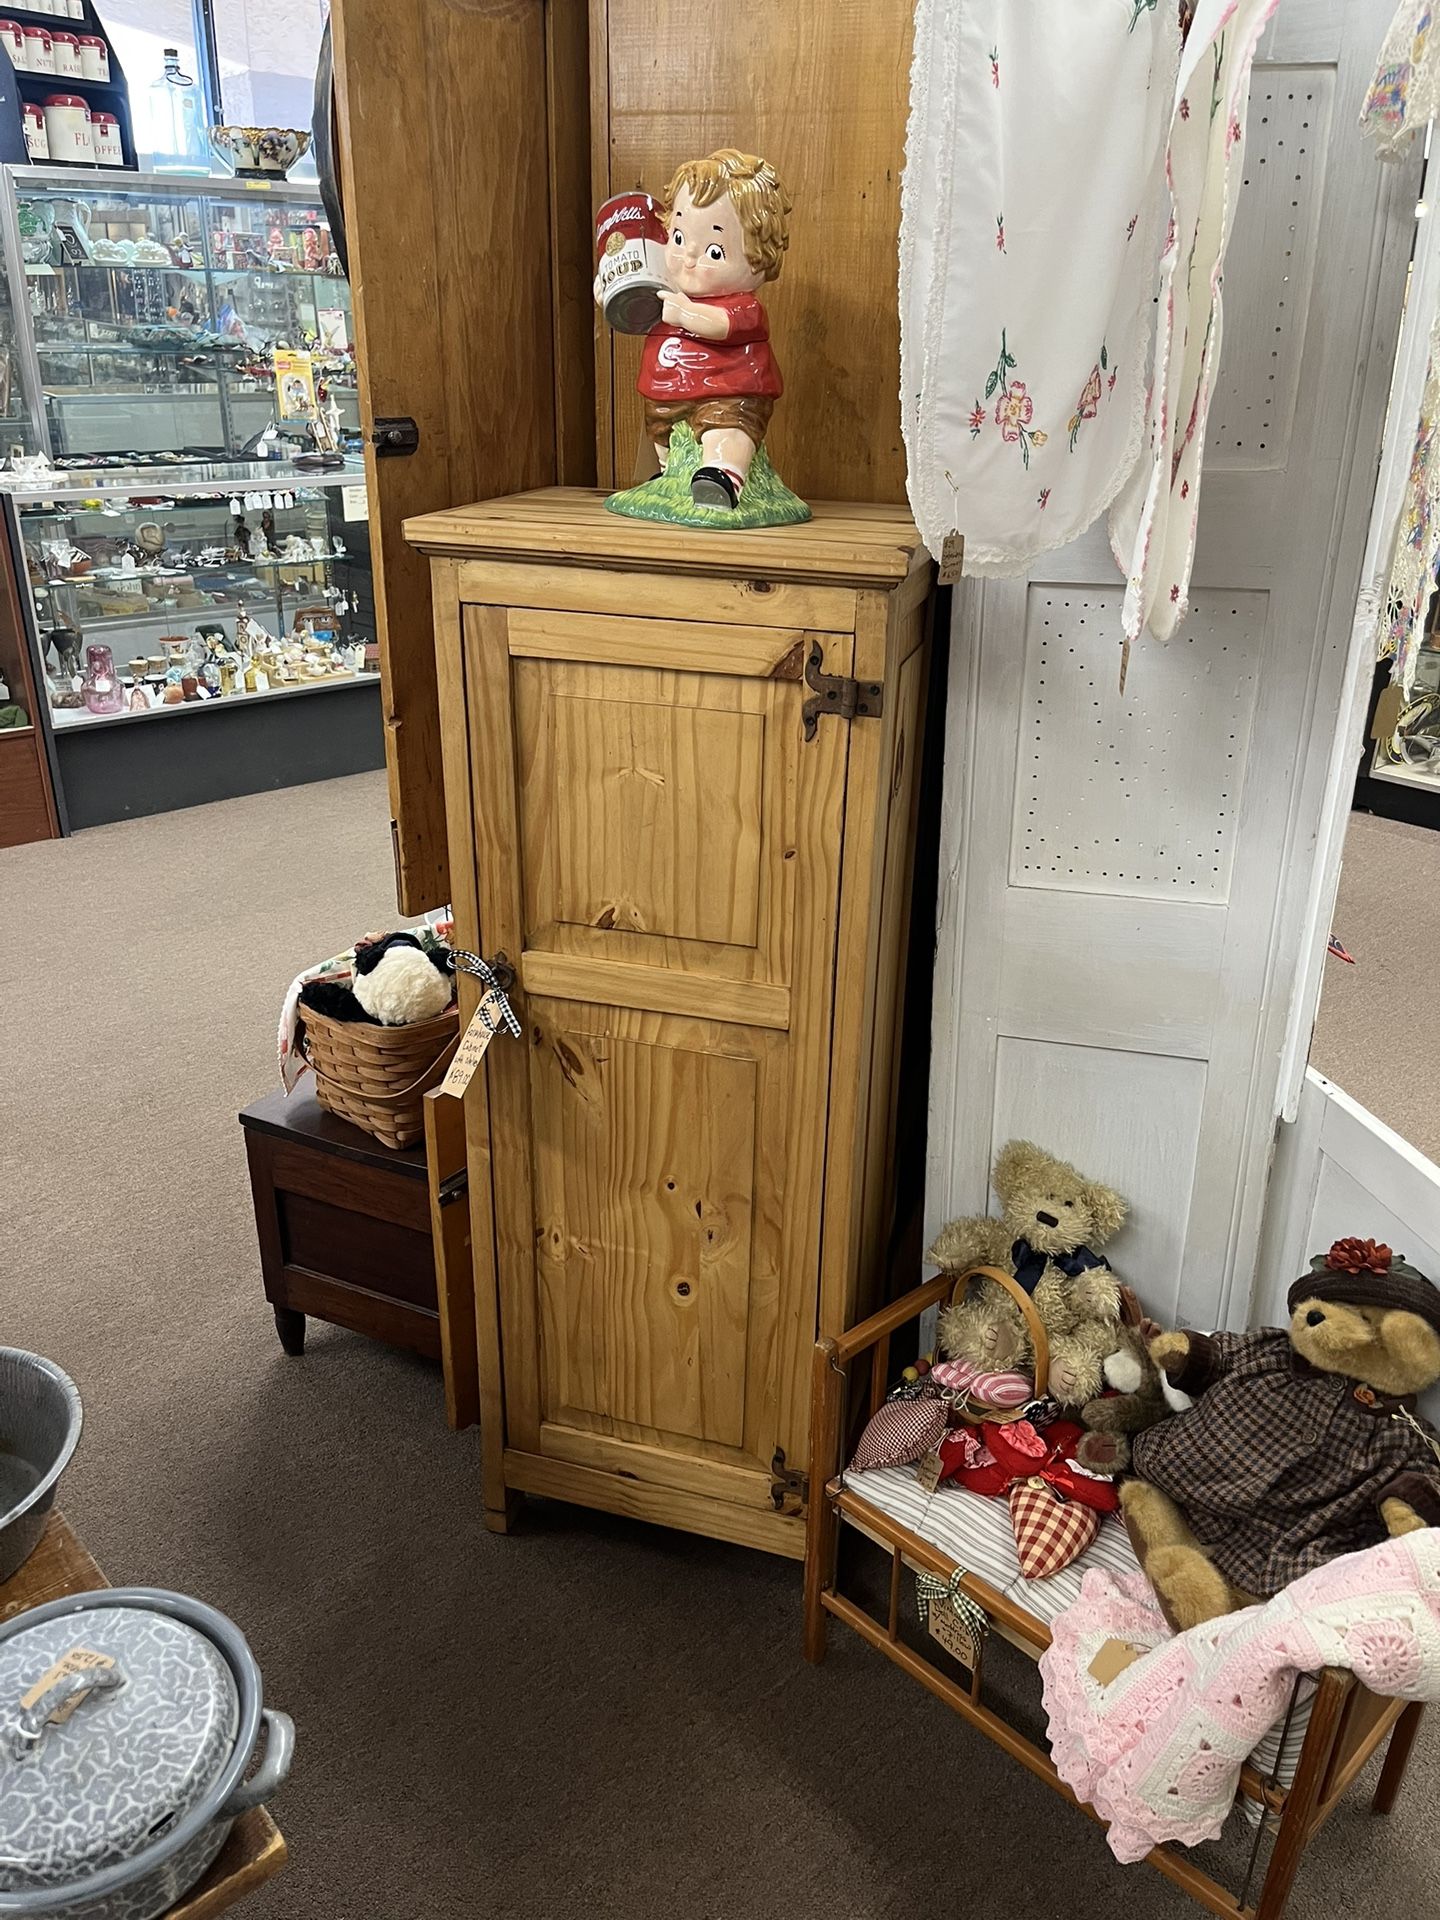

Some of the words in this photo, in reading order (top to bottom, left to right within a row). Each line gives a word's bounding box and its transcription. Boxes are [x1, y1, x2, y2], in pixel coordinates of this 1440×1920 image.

[74, 132, 90, 146] FL
[604, 250, 640, 271] TOMATO
[601, 259, 643, 291] SOUP
